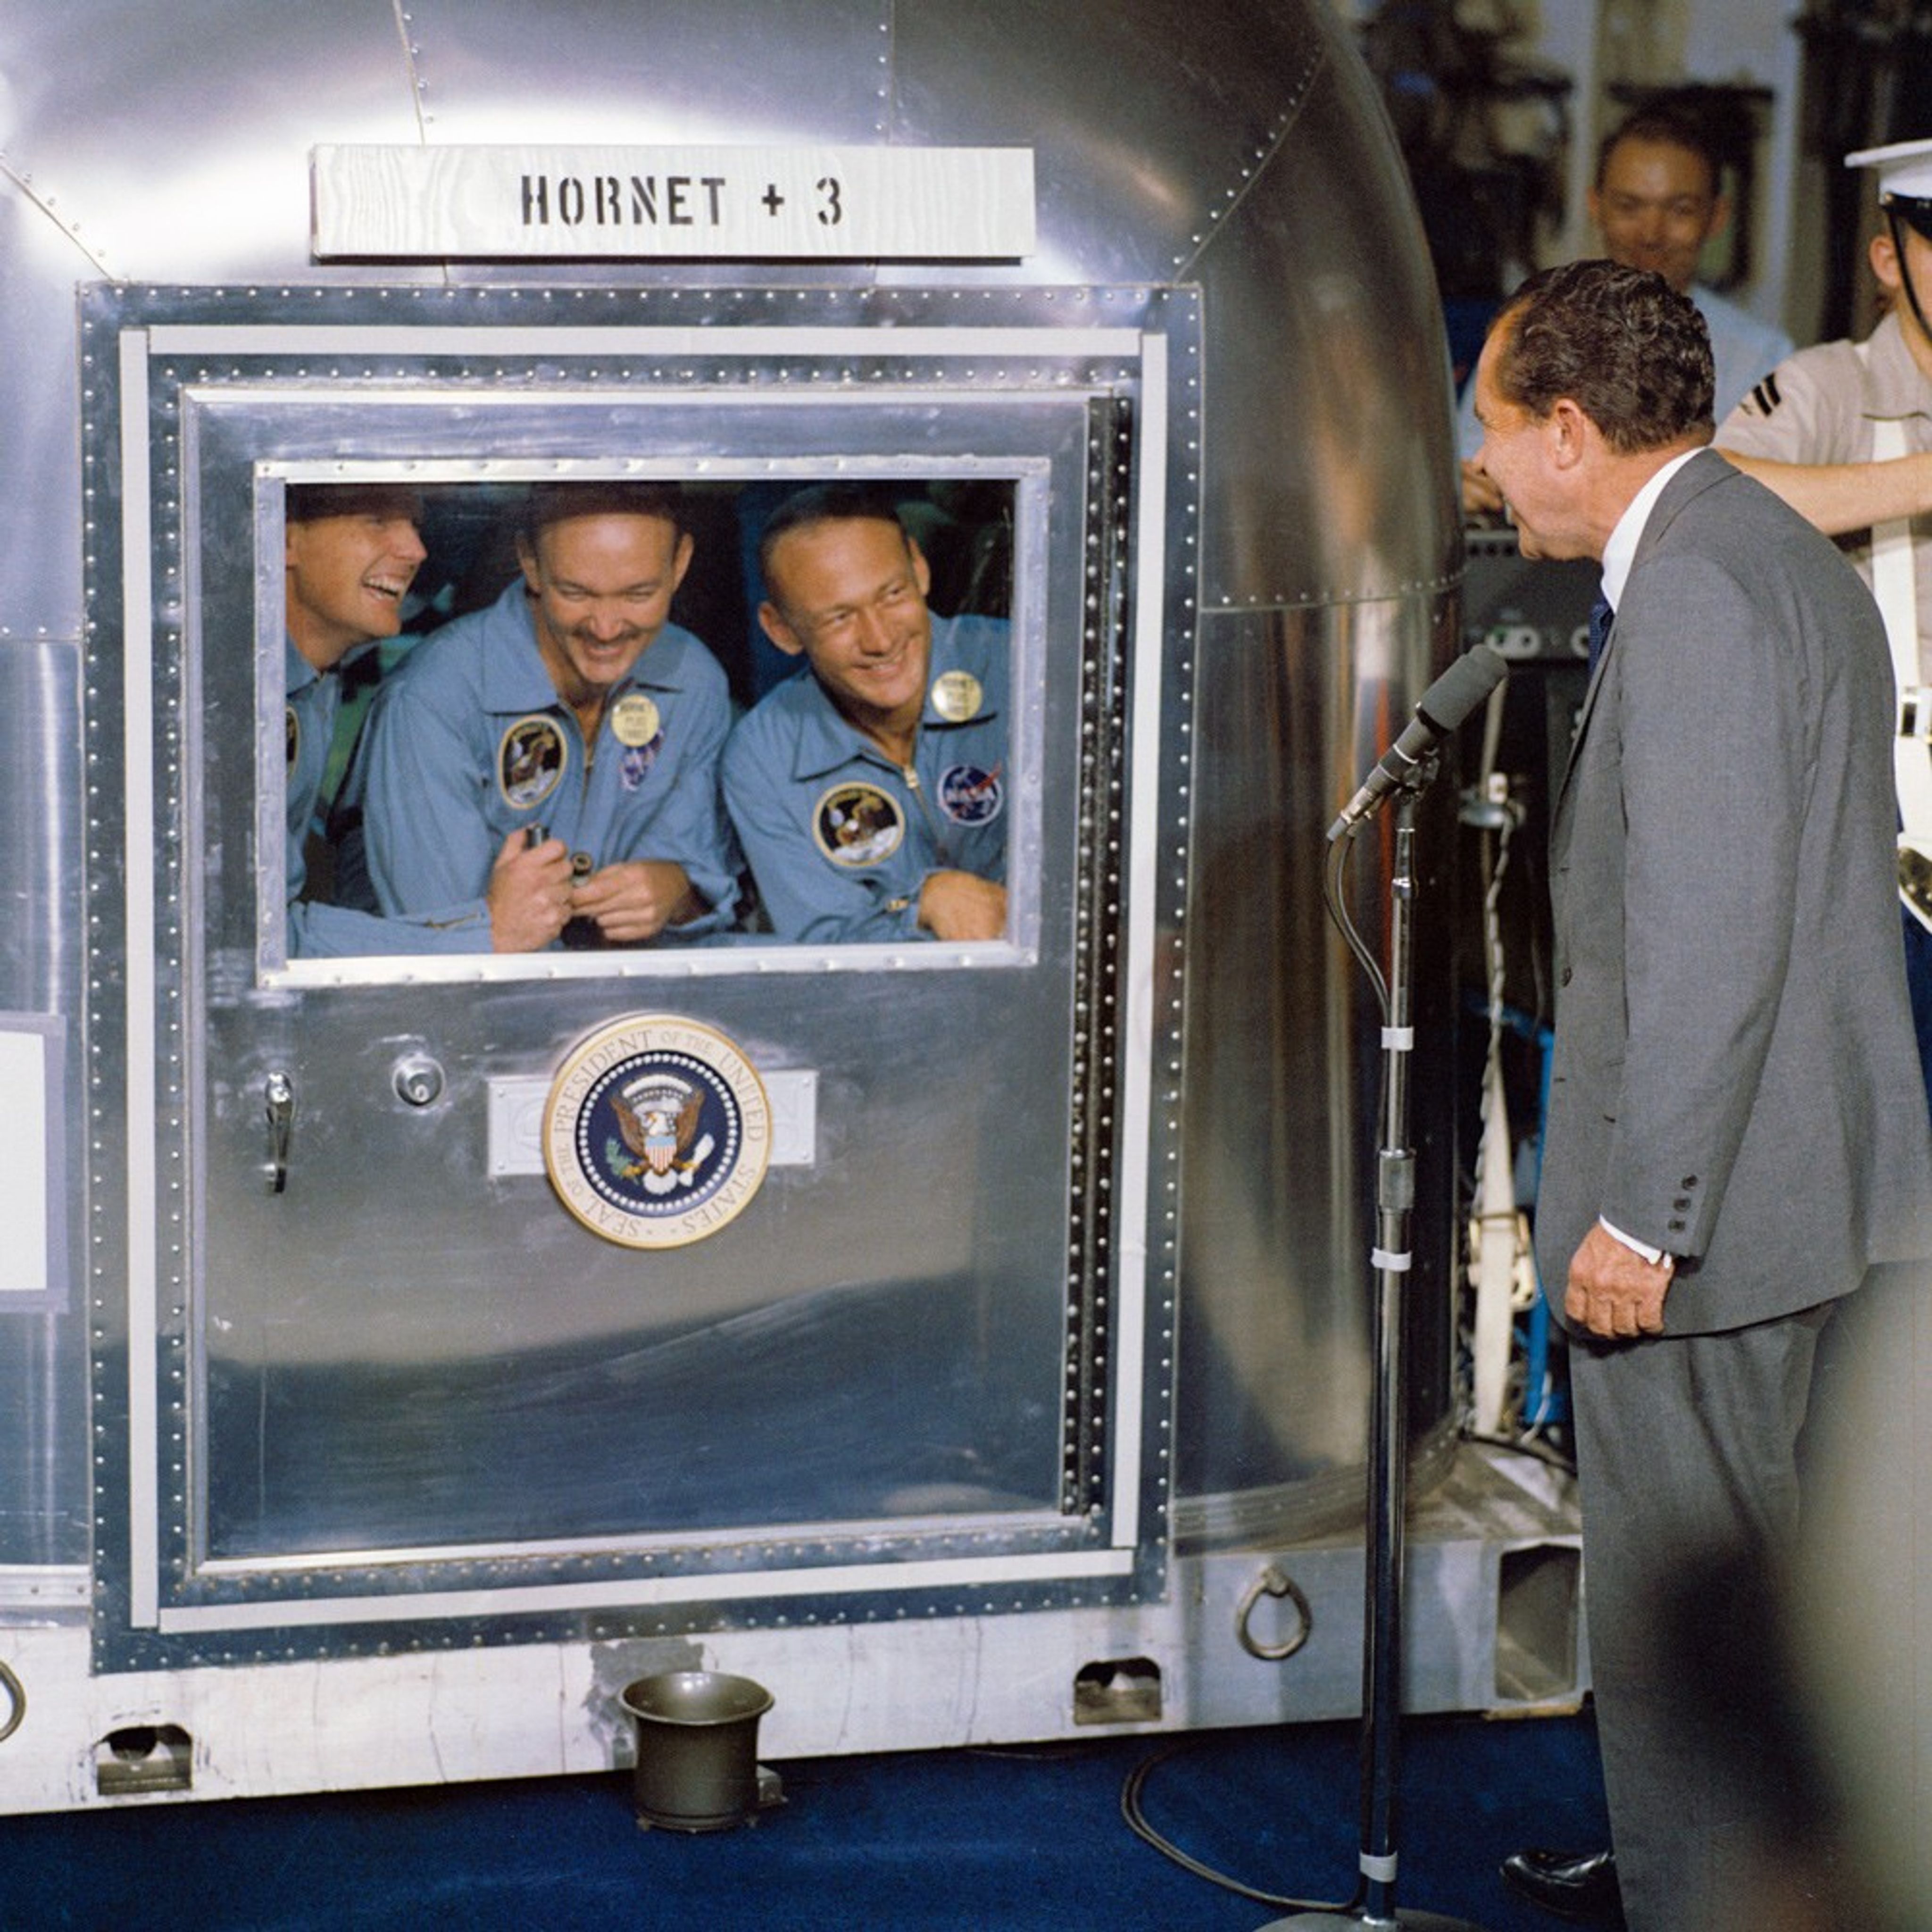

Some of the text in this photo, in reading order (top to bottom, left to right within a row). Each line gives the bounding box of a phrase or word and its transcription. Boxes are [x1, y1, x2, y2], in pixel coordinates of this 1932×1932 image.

[521, 175, 841, 225] HORNET + 3
[660, 1030, 680, 1044] OF
[554, 1029, 653, 1133] PRESIDENT
[717, 1049, 766, 1142] UNITED
[583, 1195, 642, 1238] SEAL
[681, 1163, 758, 1234] STATES
